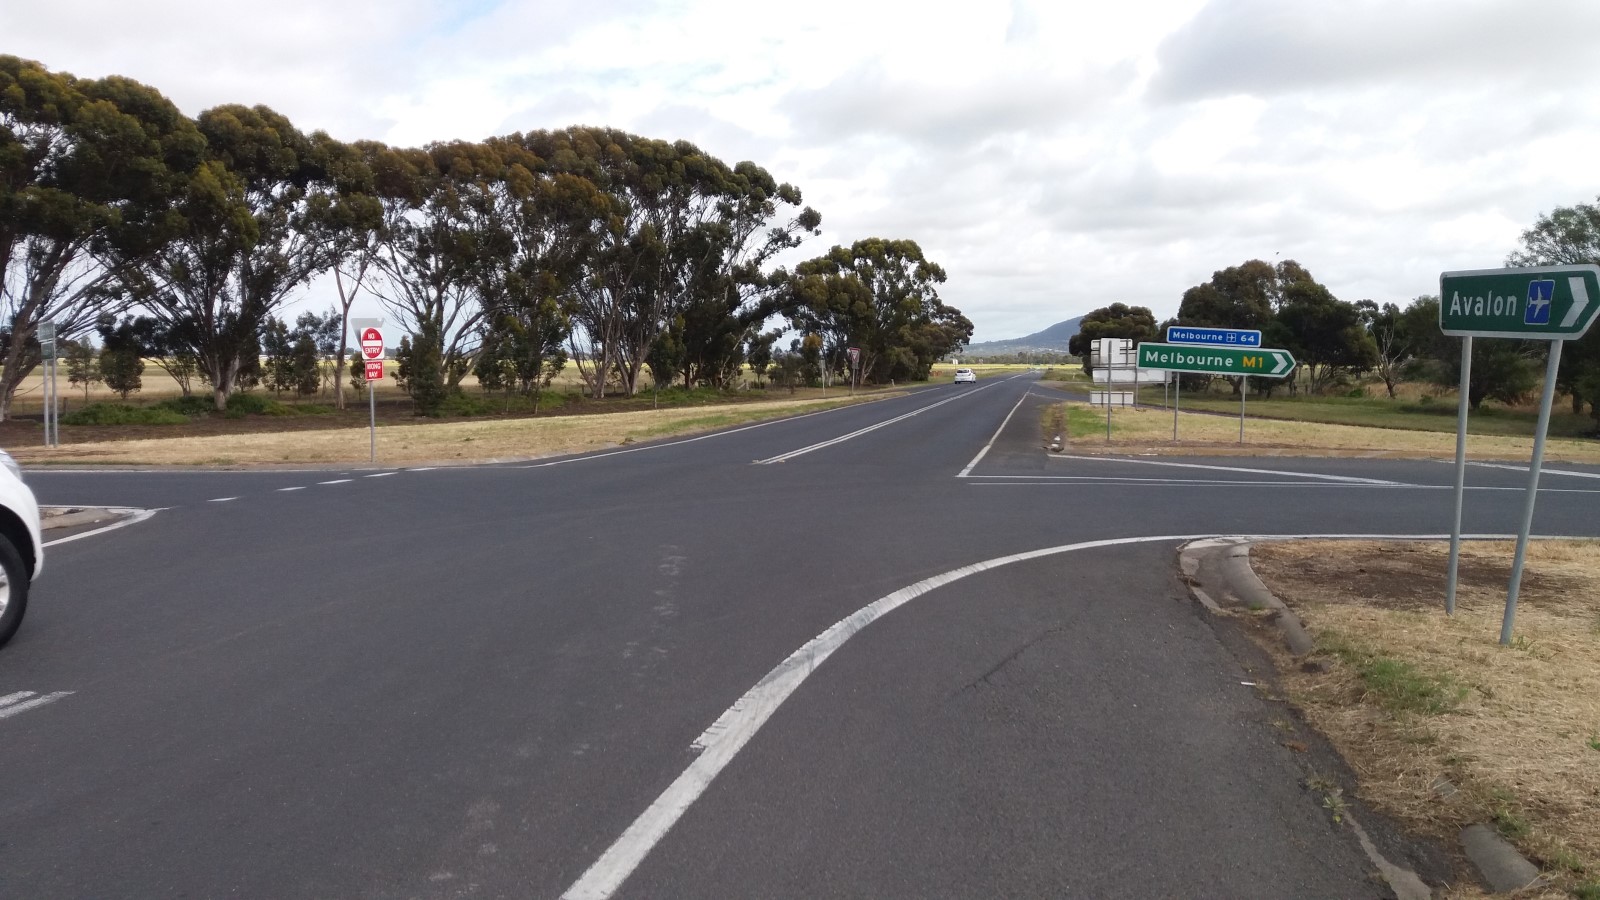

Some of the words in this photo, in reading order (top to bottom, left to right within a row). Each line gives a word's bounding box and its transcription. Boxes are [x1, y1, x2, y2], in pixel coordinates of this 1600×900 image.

[1449, 290, 1518, 316] Avalon
[1172, 331, 1223, 341] Melbourne
[1240, 334, 1255, 343] 64
[1145, 350, 1234, 367] Melbourne
[1242, 355, 1264, 368] M1
